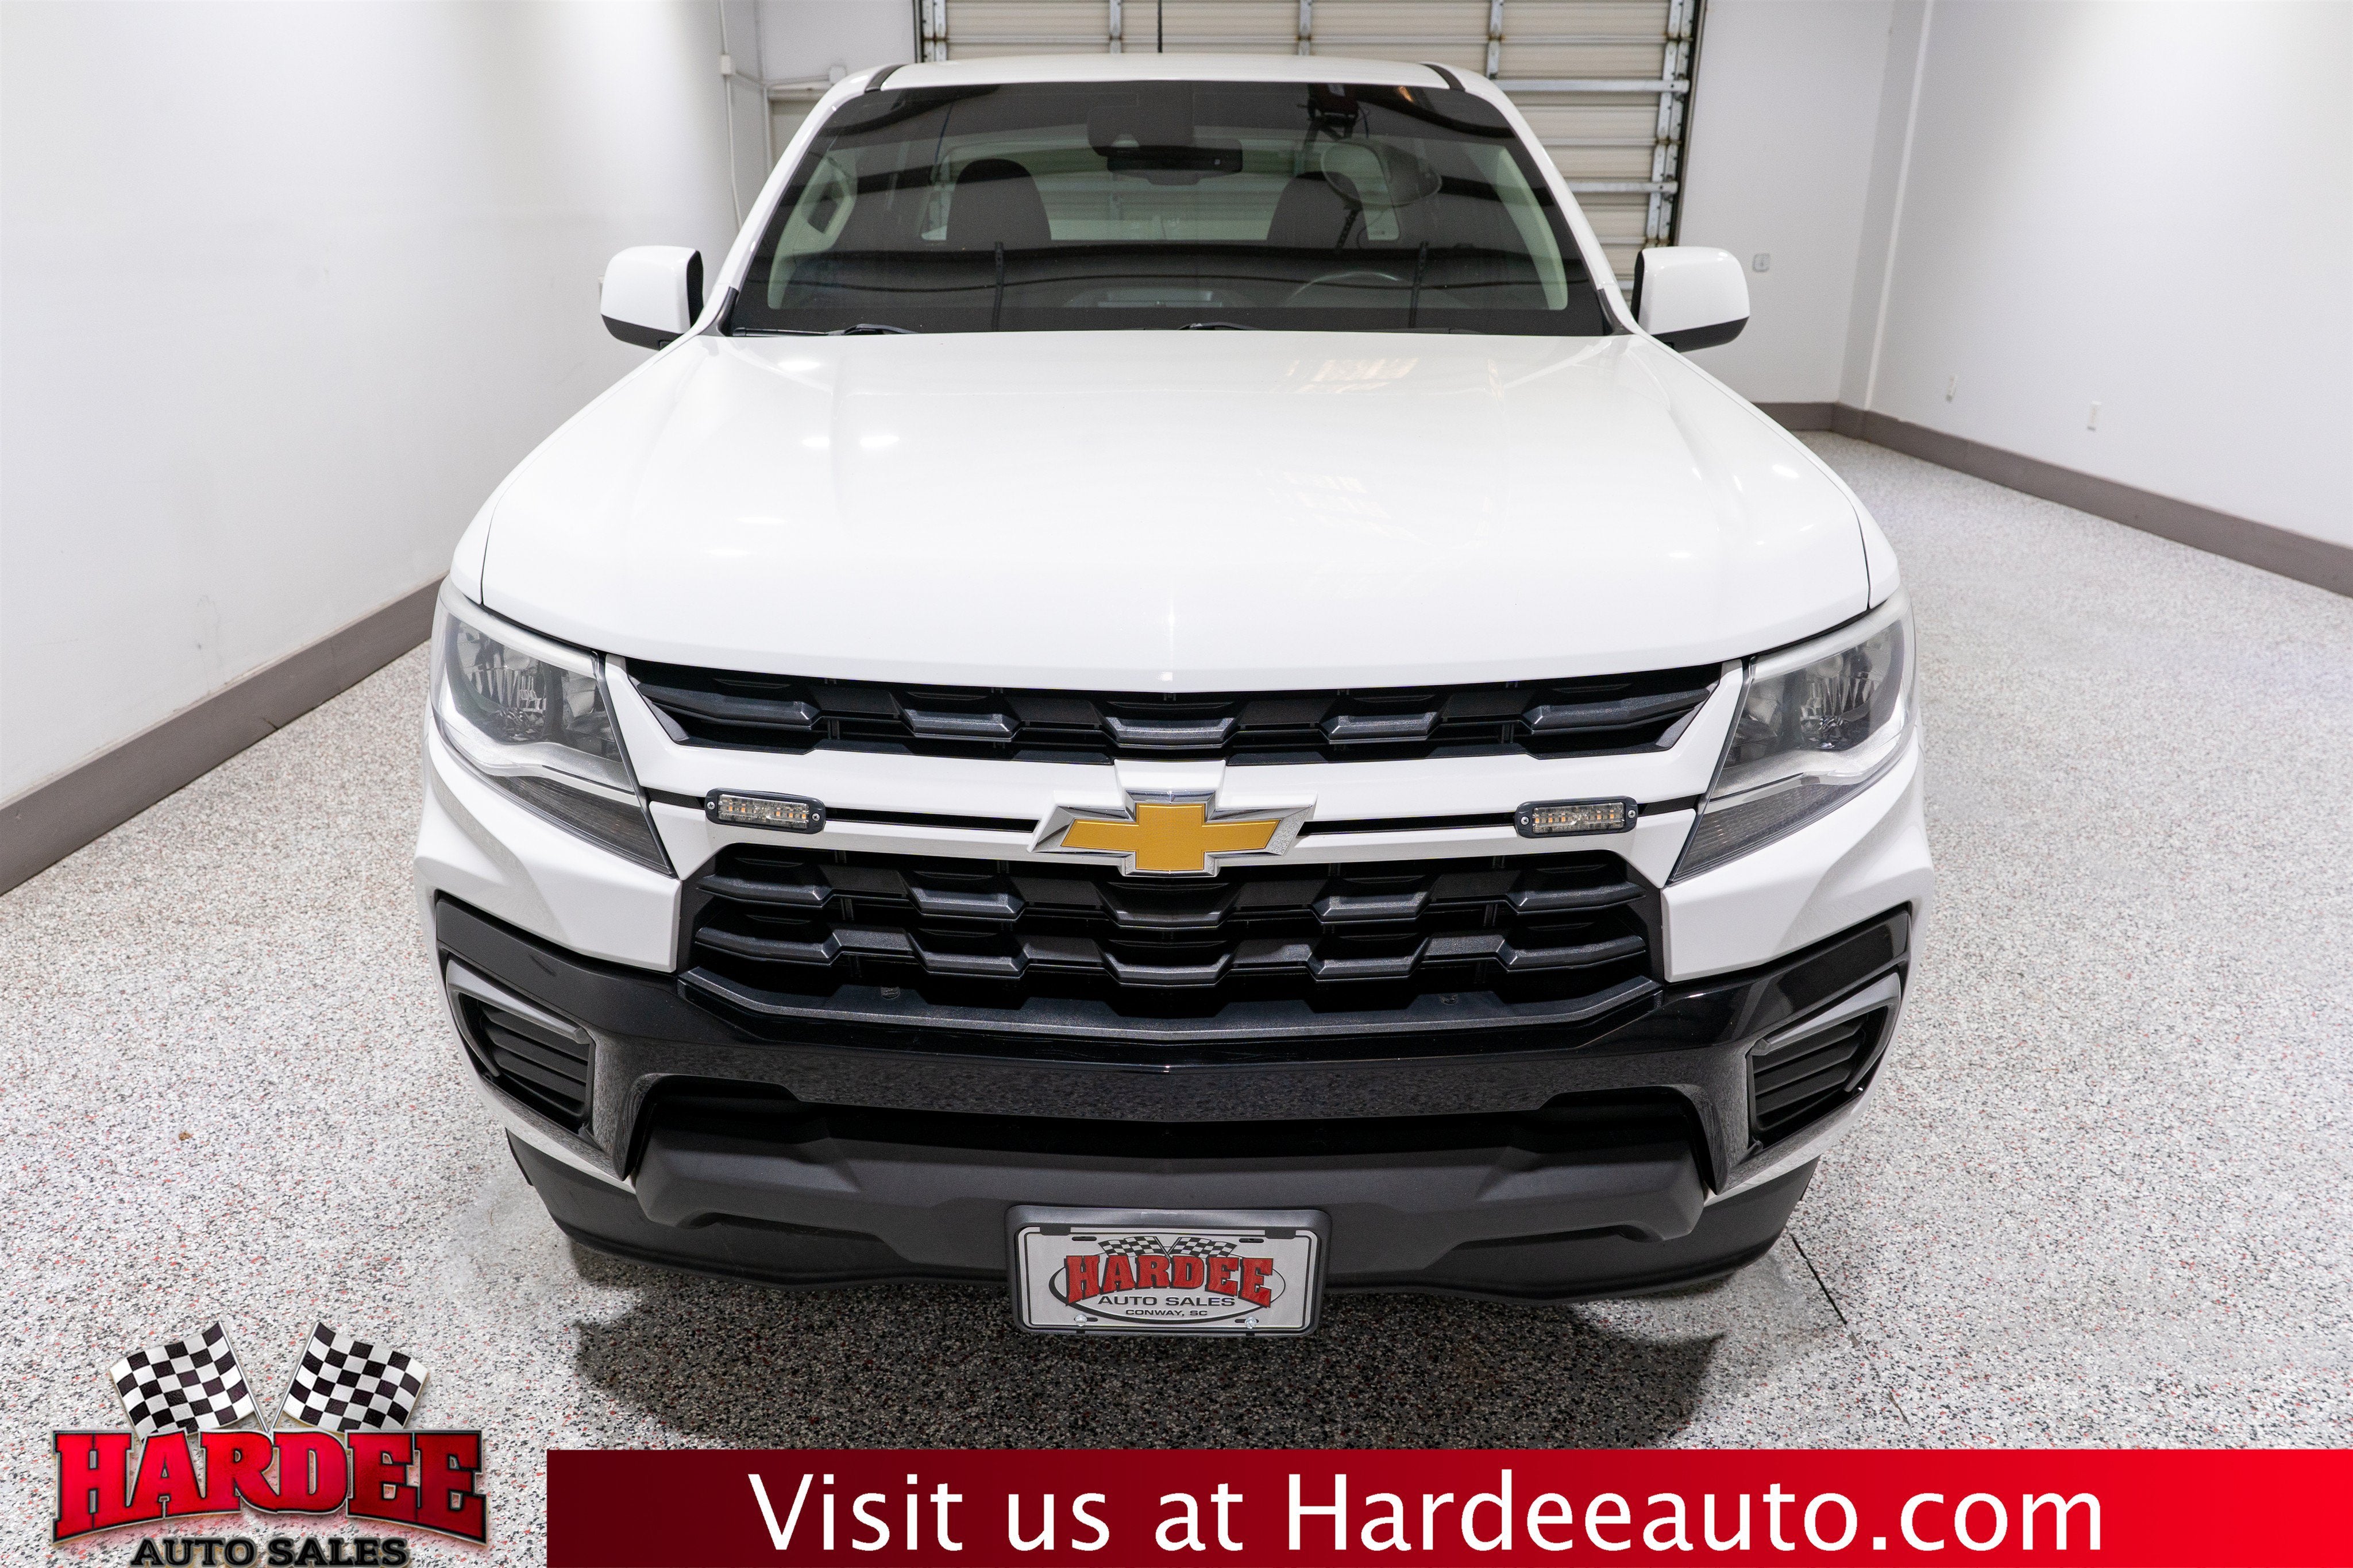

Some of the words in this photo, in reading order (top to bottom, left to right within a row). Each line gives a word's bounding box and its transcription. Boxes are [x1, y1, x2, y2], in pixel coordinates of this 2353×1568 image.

[1065, 1254, 1274, 1308] HARDEE
[1098, 1295, 1158, 1306] AUTO
[1165, 1296, 1236, 1307] SALES
[1125, 1309, 1185, 1317] CONWAY,
